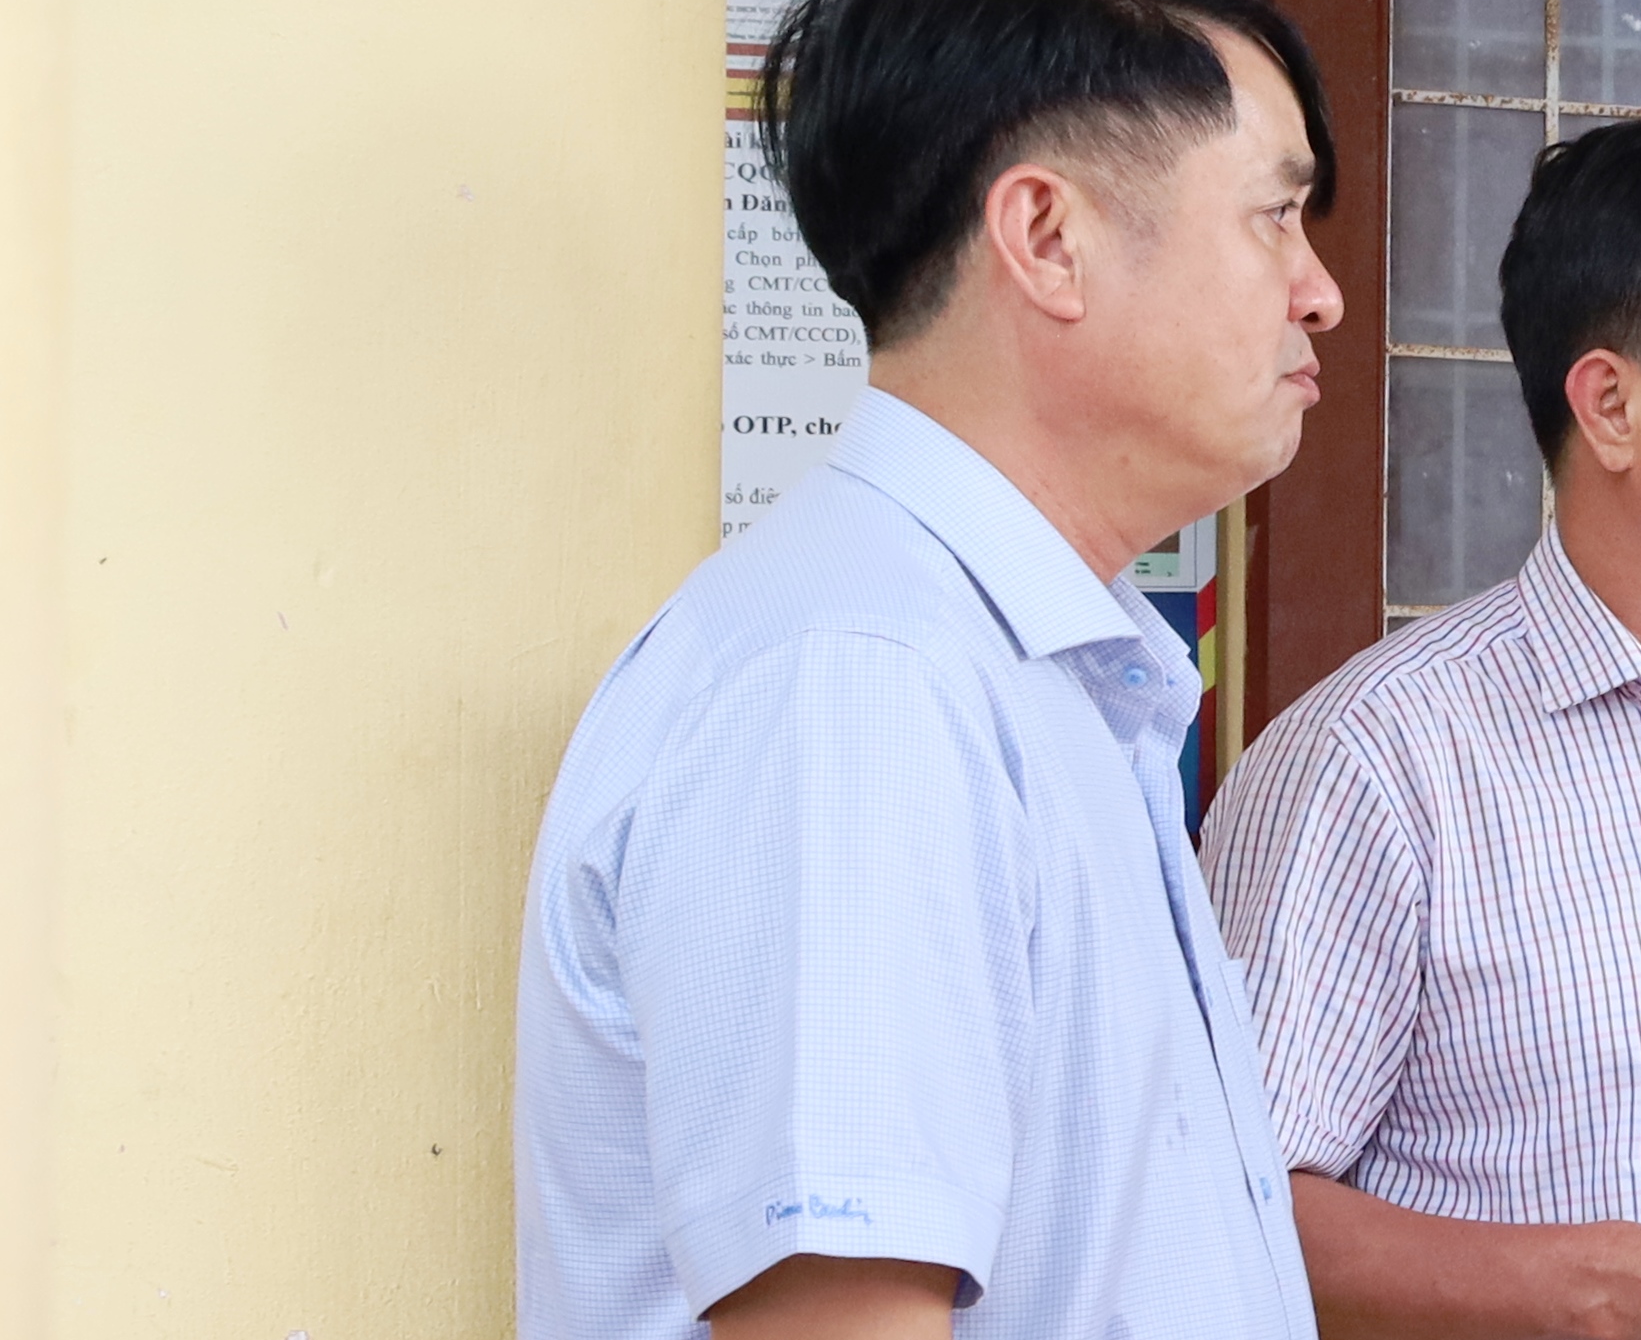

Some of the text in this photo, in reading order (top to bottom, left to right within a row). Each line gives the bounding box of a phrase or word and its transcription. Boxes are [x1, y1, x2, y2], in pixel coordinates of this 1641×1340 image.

[727, 222, 758, 245] cấp
[735, 250, 782, 268] Chọn
[746, 300, 793, 319] thông
[802, 303, 824, 317] tin
[744, 326, 861, 345] CMT/CCCD),
[725, 350, 862, 369] xác thực Bấm
[733, 414, 798, 437] OTP,
[724, 482, 744, 505] số
